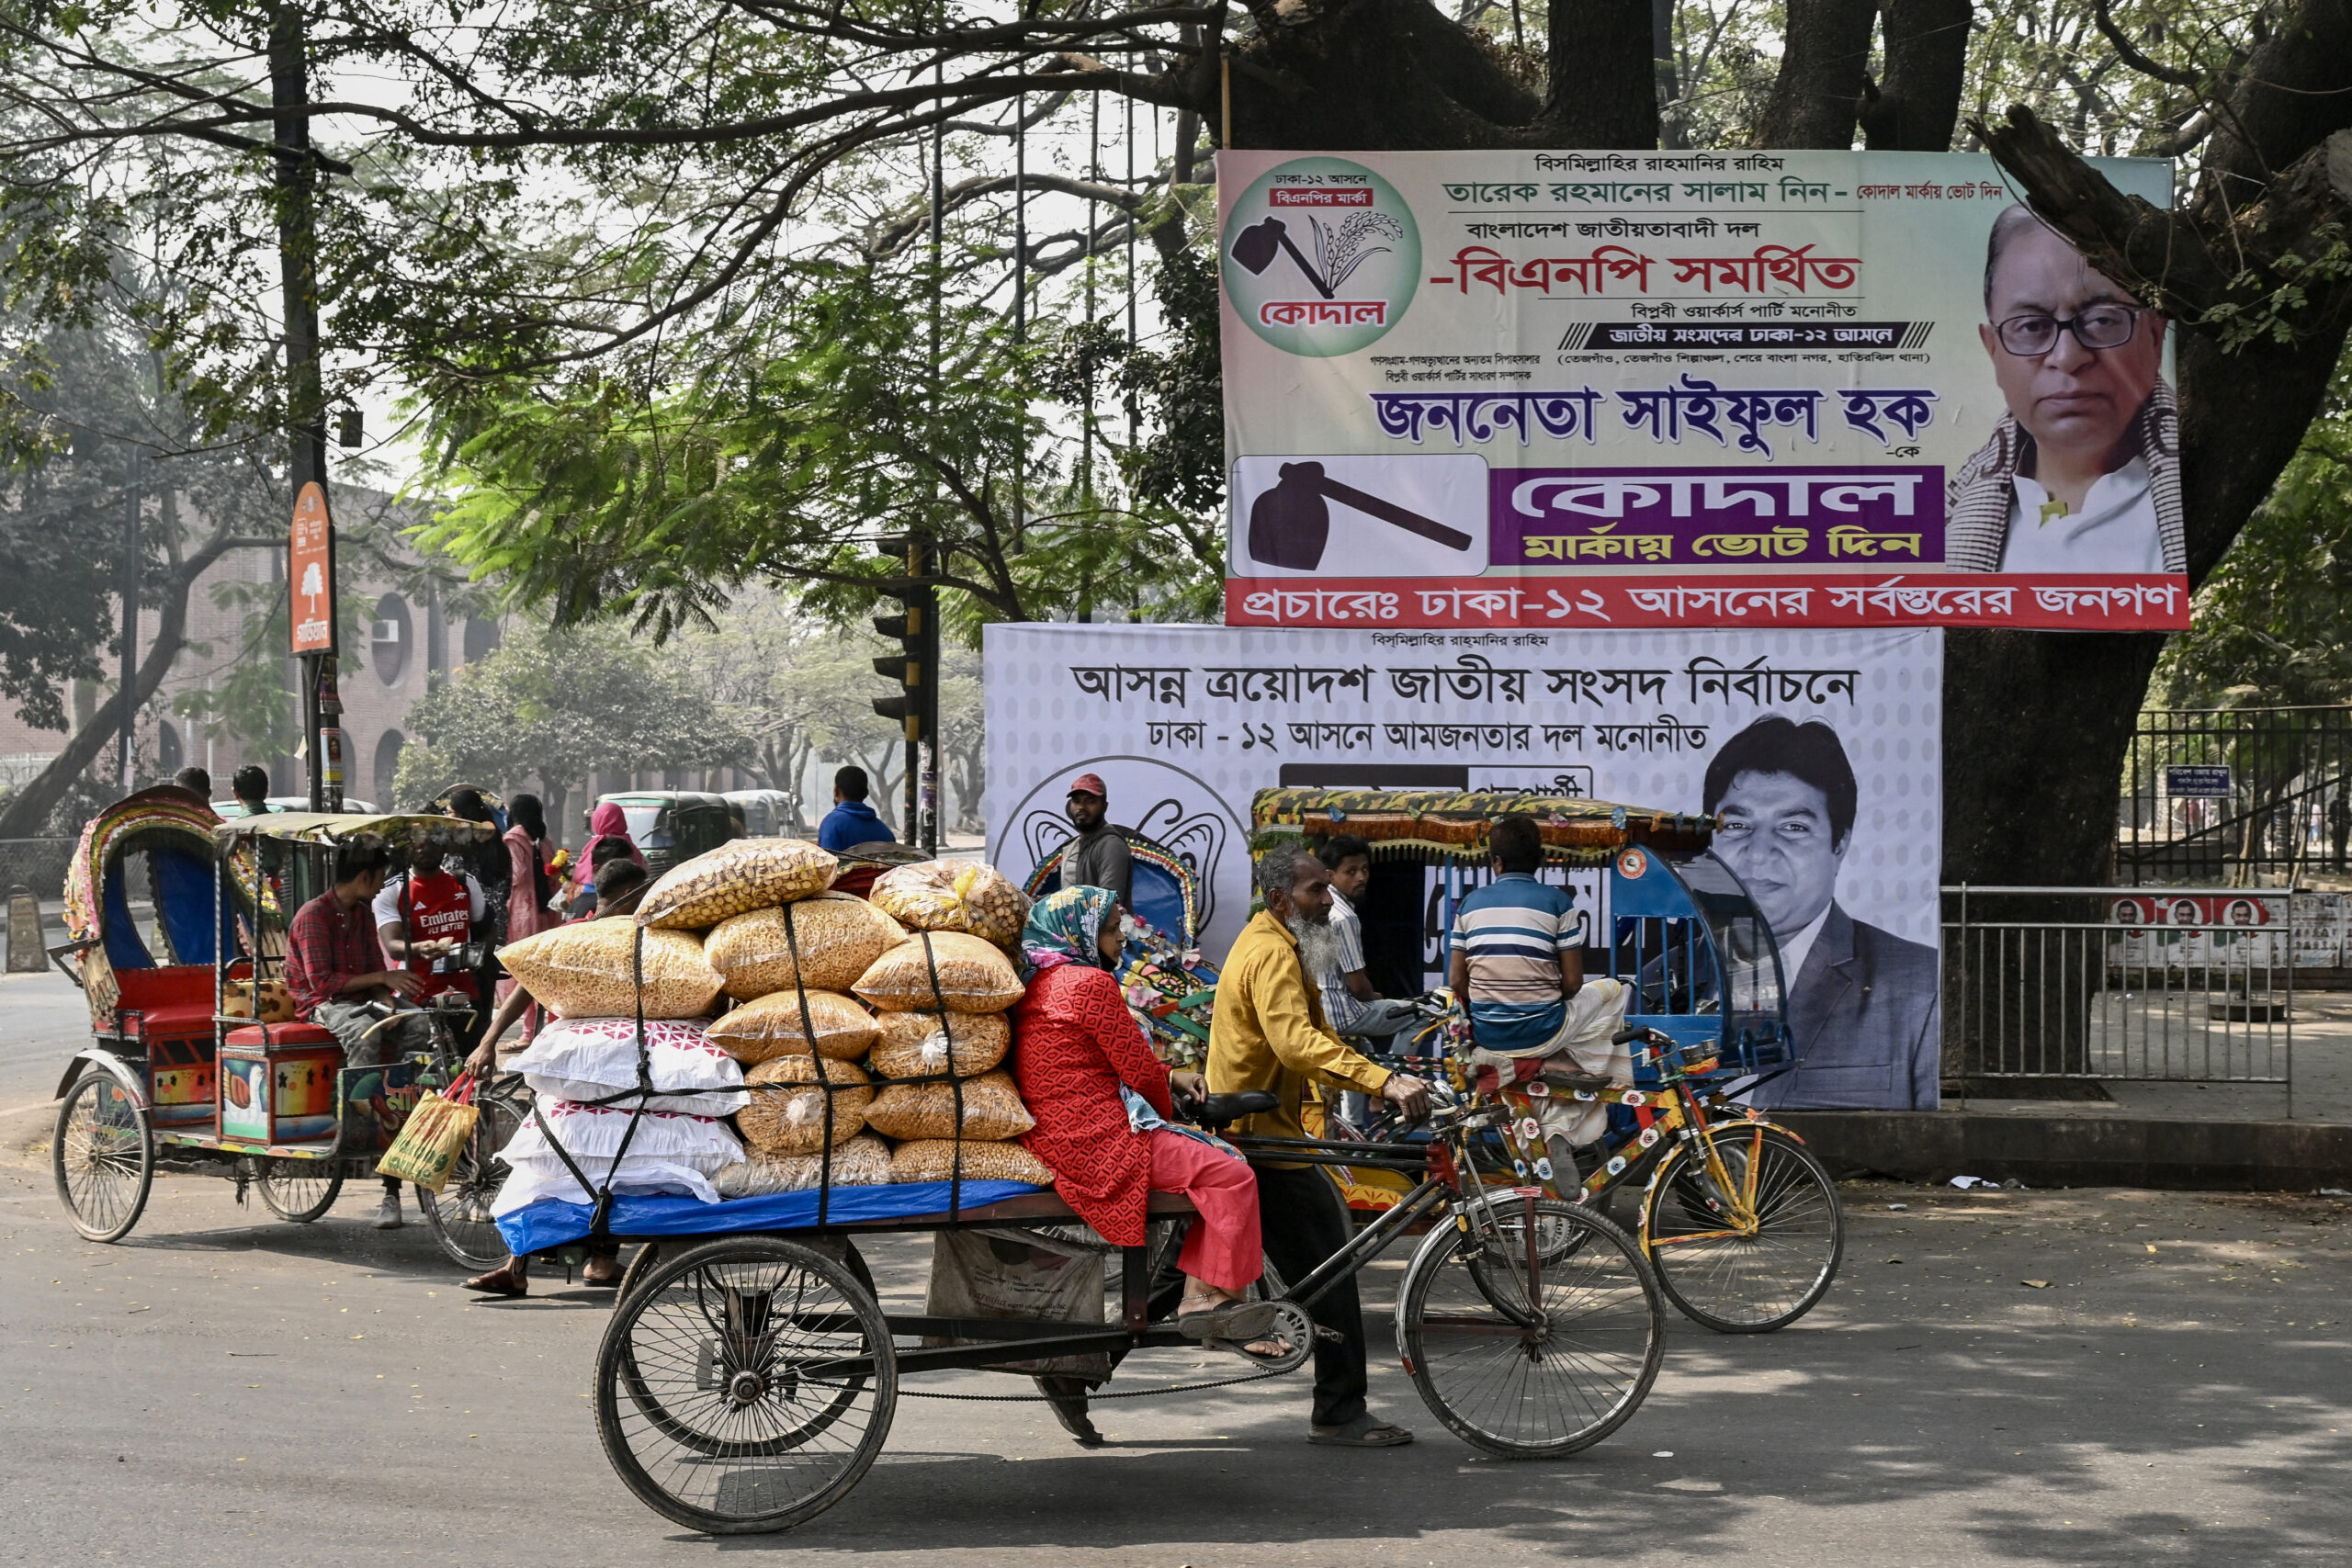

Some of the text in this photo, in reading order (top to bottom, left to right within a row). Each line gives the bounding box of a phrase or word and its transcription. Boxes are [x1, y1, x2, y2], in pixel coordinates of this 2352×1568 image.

[1533, 153, 1785, 172] বিসমিল্লাহির রাহমানির রাহিম
[1273, 175, 1368, 185] ঢাকা-১২ আসনে
[1276, 190, 1367, 204] বিএনপির মার্কা
[1442, 182, 1540, 203] তারেক
[1547, 182, 1674, 203] রহমানের
[1680, 181, 1770, 202] সালাম
[1857, 185, 1901, 199] কোদাল
[1905, 180, 1943, 199] মার্কায়
[1947, 182, 1976, 199] ভোট
[1979, 180, 2007, 199] দিন
[1464, 219, 1761, 239] বাংলাদেশ জাতীয়তাবাদী দল
[1668, 244, 1863, 294] সমর্থিত
[1260, 301, 1386, 326] কোদাল
[1631, 302, 1858, 319] বিপ্লবী ওয়ার্কার্স পার্টি মনোনীত
[1609, 323, 1893, 344] জাতীয় সংসদের ঢাকা-১২ আসনে
[1838, 352, 1894, 362] হাতিরঝিল
[1468, 372, 1497, 380] সাধারণ
[1498, 371, 1532, 380] সম্পাদক
[1370, 374, 1935, 457] জননেতা সাইফুল হক
[1512, 475, 1923, 517] কোদাল
[1522, 522, 1922, 560] মার্কায় ভোট দিন
[1243, 577, 2181, 622] প্রচারেঃ ঢাকা-১২ আসনের সর্বস্তরের জনগণ
[1511, 633, 1549, 647] রাহিম
[1069, 654, 1861, 708] আসন্ন ত্রয়োদশ জাতীয় সংসদ নির্বাচনে
[1147, 720, 1207, 749] ঢাকা
[1242, 723, 1278, 752] ১২
[1287, 720, 1375, 750] আসনে
[1383, 721, 1533, 751] আমজনতার
[1540, 725, 1586, 751] দল
[1592, 715, 1710, 752] মনোনীত
[419, 910, 469, 928] Emirates
[428, 922, 465, 934] FLY BETTER
